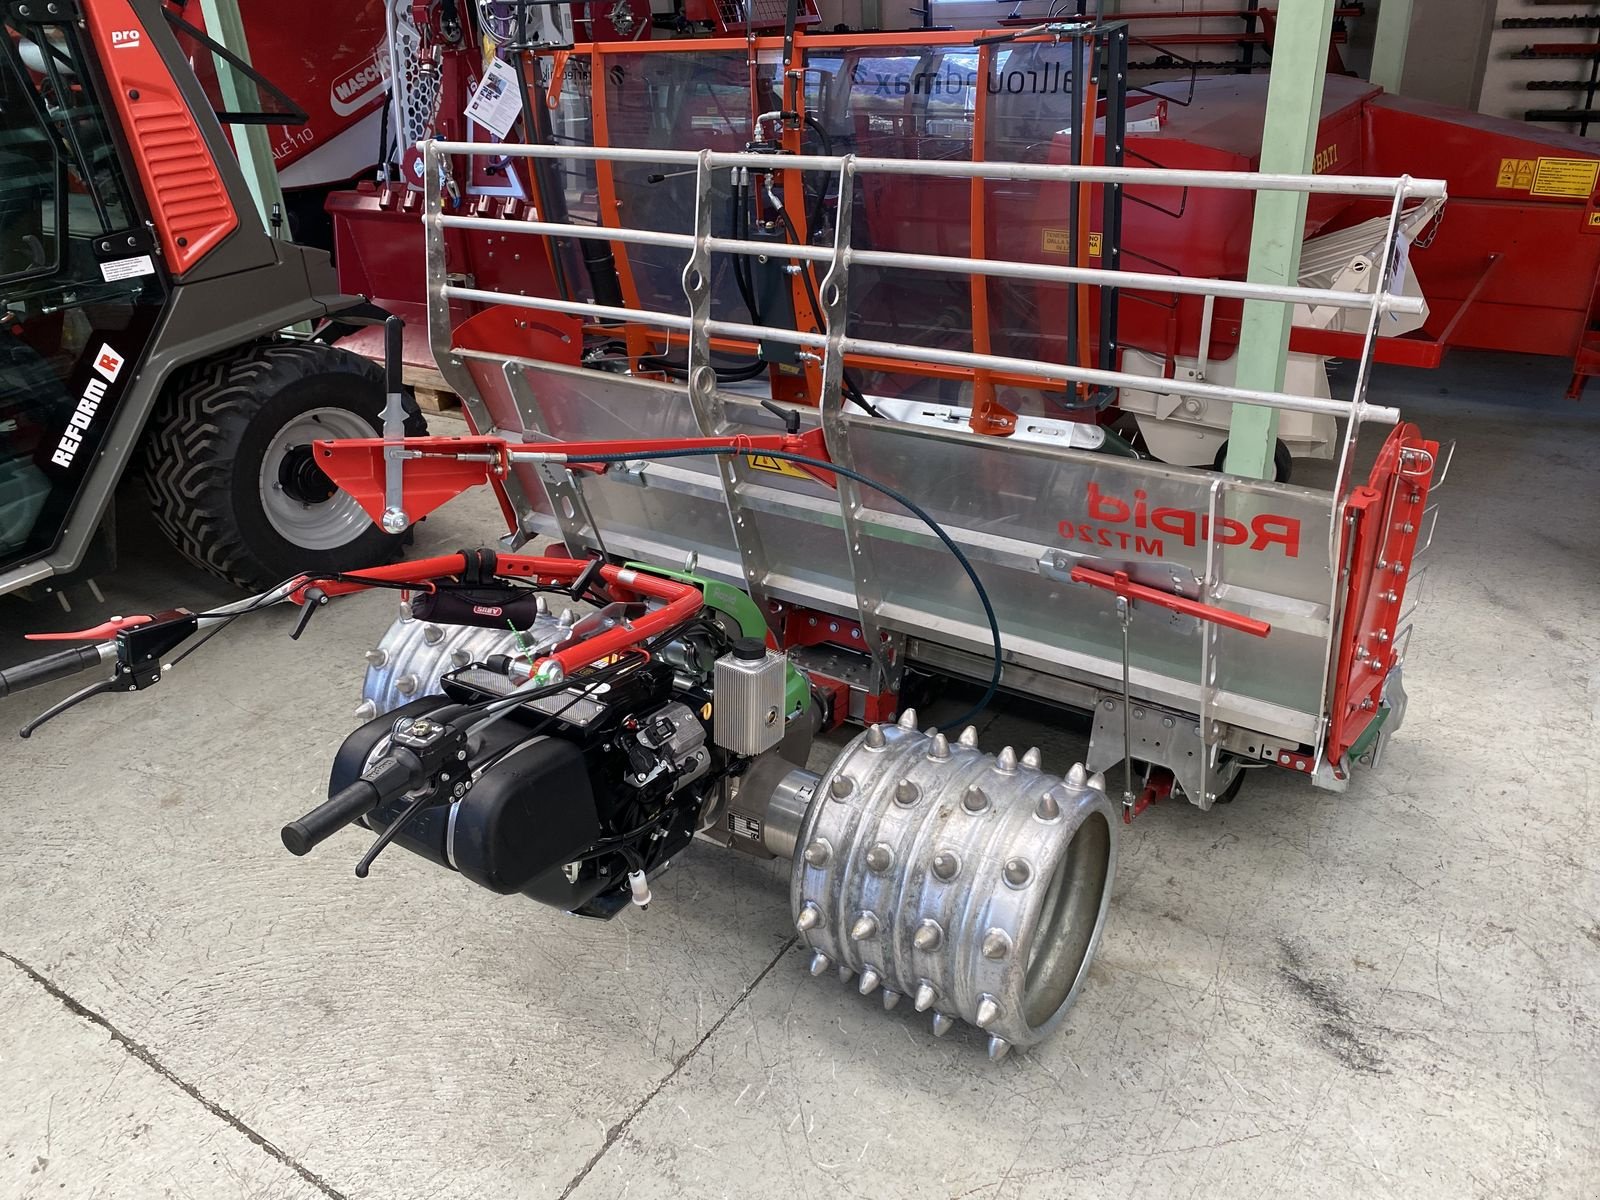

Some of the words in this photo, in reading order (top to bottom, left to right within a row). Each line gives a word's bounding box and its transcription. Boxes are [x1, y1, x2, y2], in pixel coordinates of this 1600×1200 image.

[111, 30, 140, 44] pro
[289, 127, 314, 149] 110
[51, 377, 108, 468] REFORM
